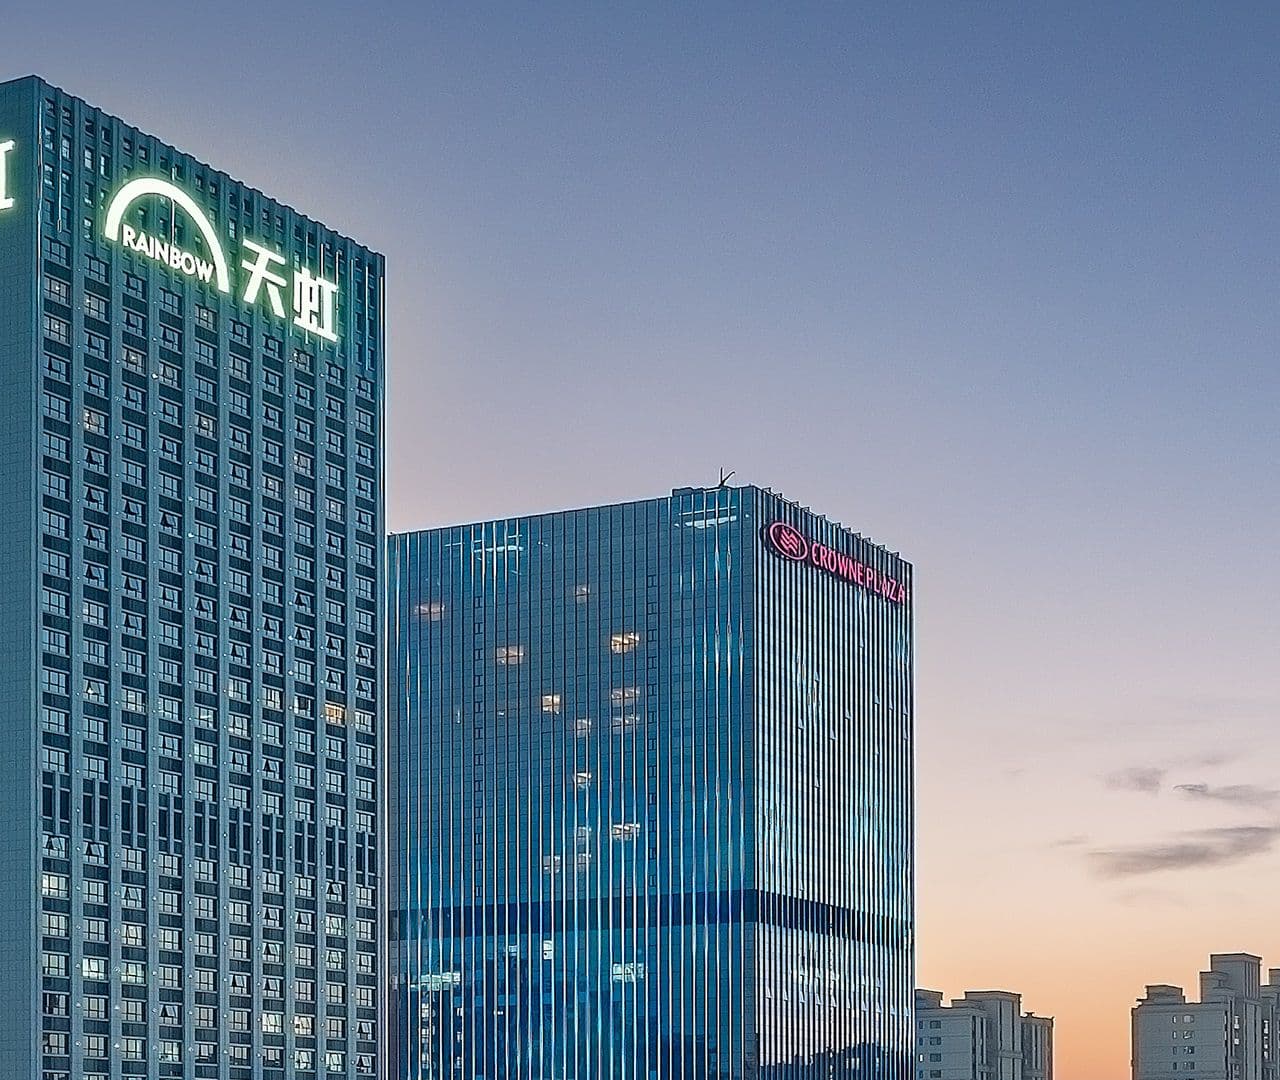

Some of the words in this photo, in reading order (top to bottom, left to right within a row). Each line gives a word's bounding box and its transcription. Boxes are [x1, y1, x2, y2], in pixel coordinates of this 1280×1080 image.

[122, 223, 215, 284] RAINBOW
[241, 238, 338, 343] 天虹
[811, 543, 865, 586] CROWNE
[865, 566, 906, 605] PLAZA
